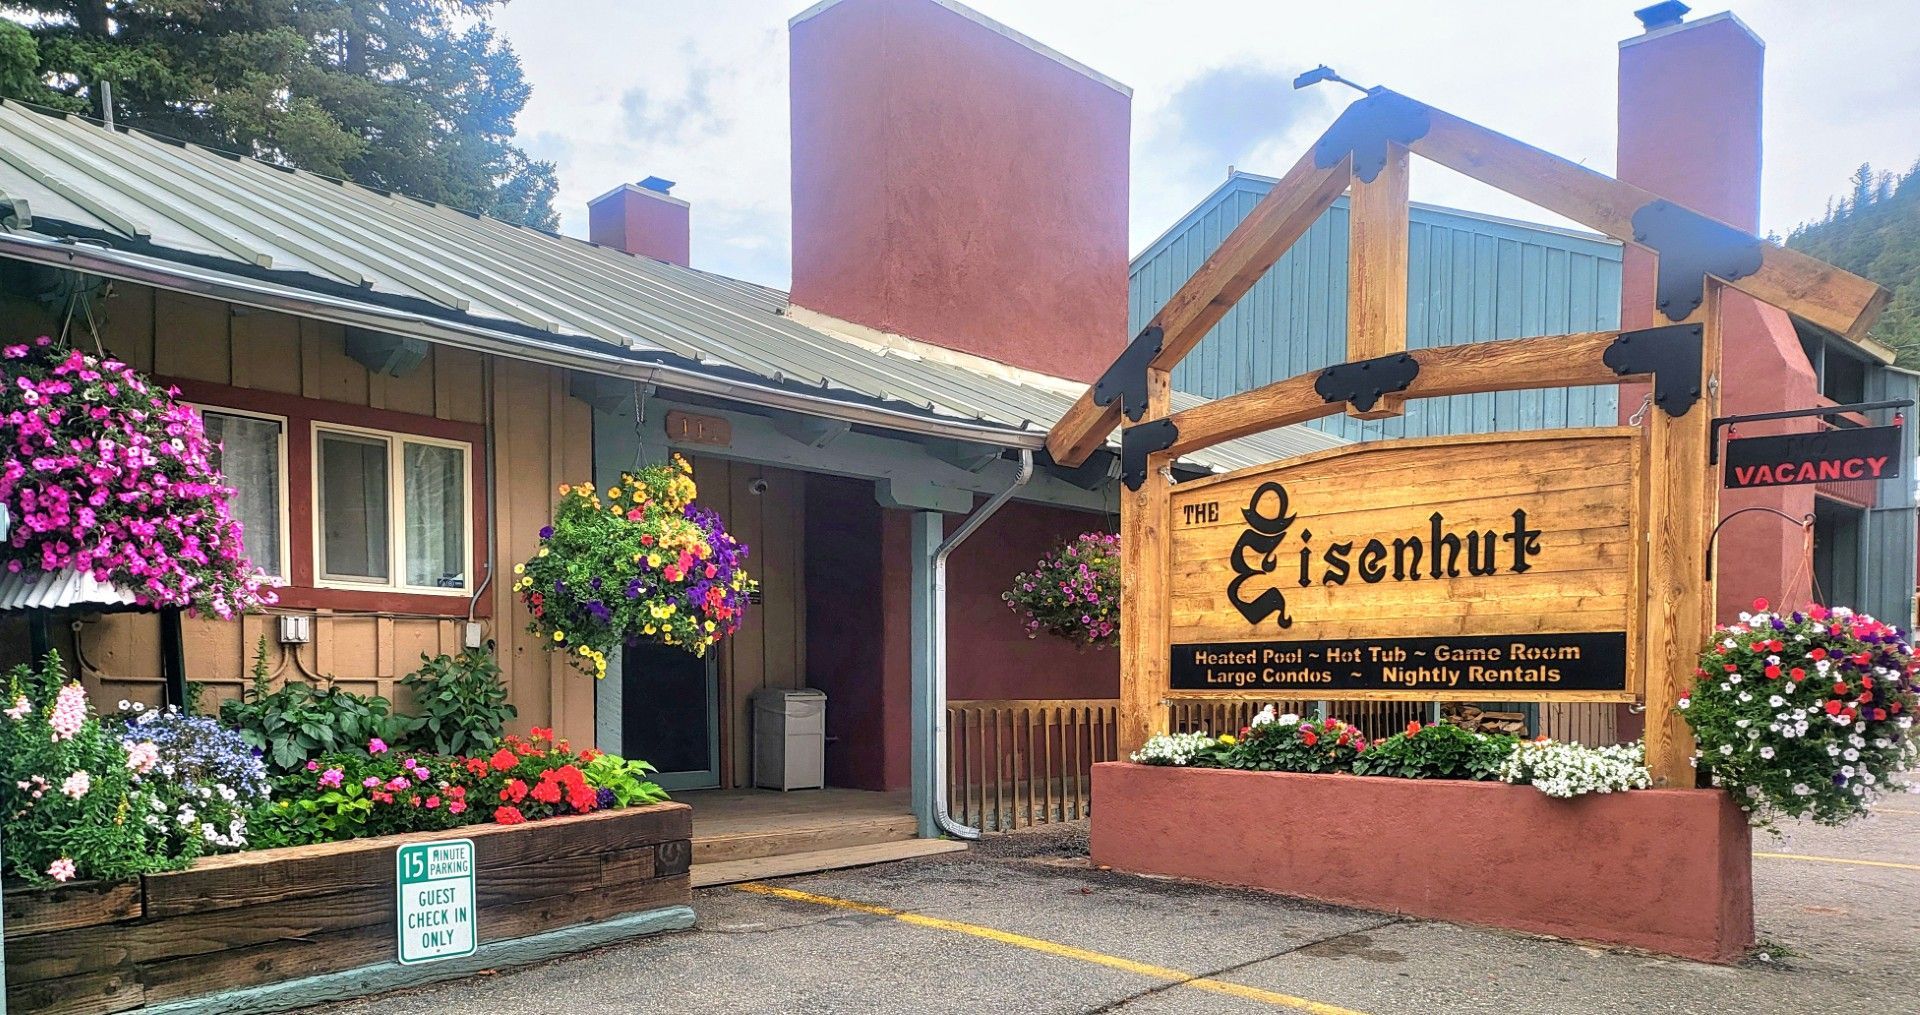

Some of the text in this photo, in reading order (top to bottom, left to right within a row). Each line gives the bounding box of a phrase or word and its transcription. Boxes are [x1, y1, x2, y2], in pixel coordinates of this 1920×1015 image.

[1735, 456, 1888, 485] VACANCY
[1184, 481, 1542, 629] THE Eisenhut
[1195, 650, 1257, 665] Heated
[1263, 649, 1302, 664] Pool
[1326, 647, 1362, 663] Hot
[1368, 646, 1407, 662] Tub
[1434, 645, 1501, 661] Game
[1510, 643, 1581, 660] Room
[1207, 669, 1257, 686] Large
[1262, 668, 1332, 683] Condos
[1383, 667, 1460, 686] Nightly
[1468, 665, 1561, 682] Rentals
[403, 848, 465, 879] 15 MINUTE
[430, 861, 468, 875] PARKING
[419, 888, 456, 907] GUEST
[408, 907, 467, 929] CHECK IN
[422, 929, 454, 949] ONLY
